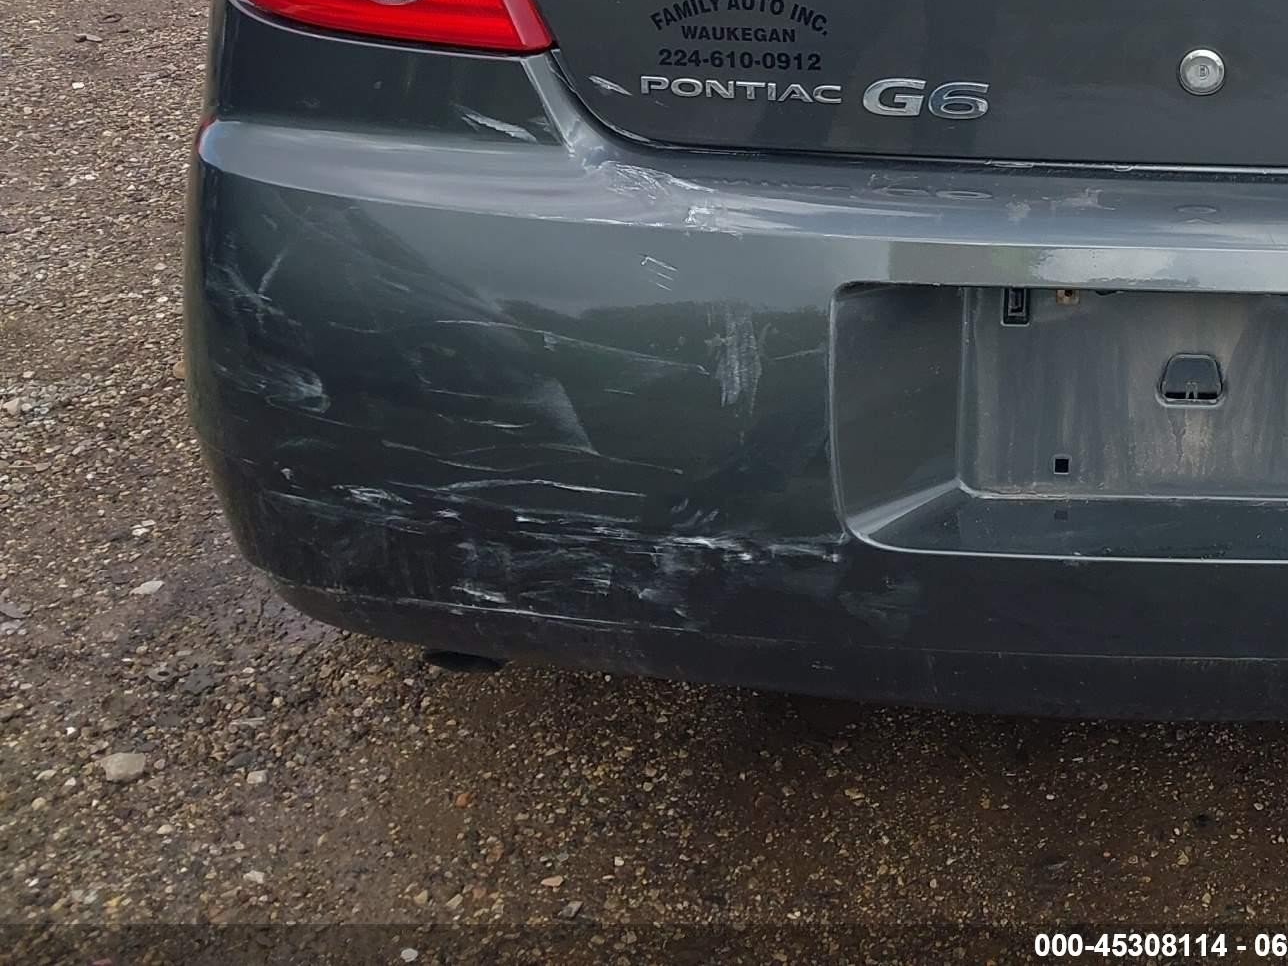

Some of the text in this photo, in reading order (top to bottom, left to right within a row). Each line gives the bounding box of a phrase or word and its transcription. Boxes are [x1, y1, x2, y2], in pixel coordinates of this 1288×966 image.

[681, 25, 796, 43] WAUKEGAN
[658, 48, 822, 71] 224-610-0912
[640, 75, 990, 120] PONTIAC G6
